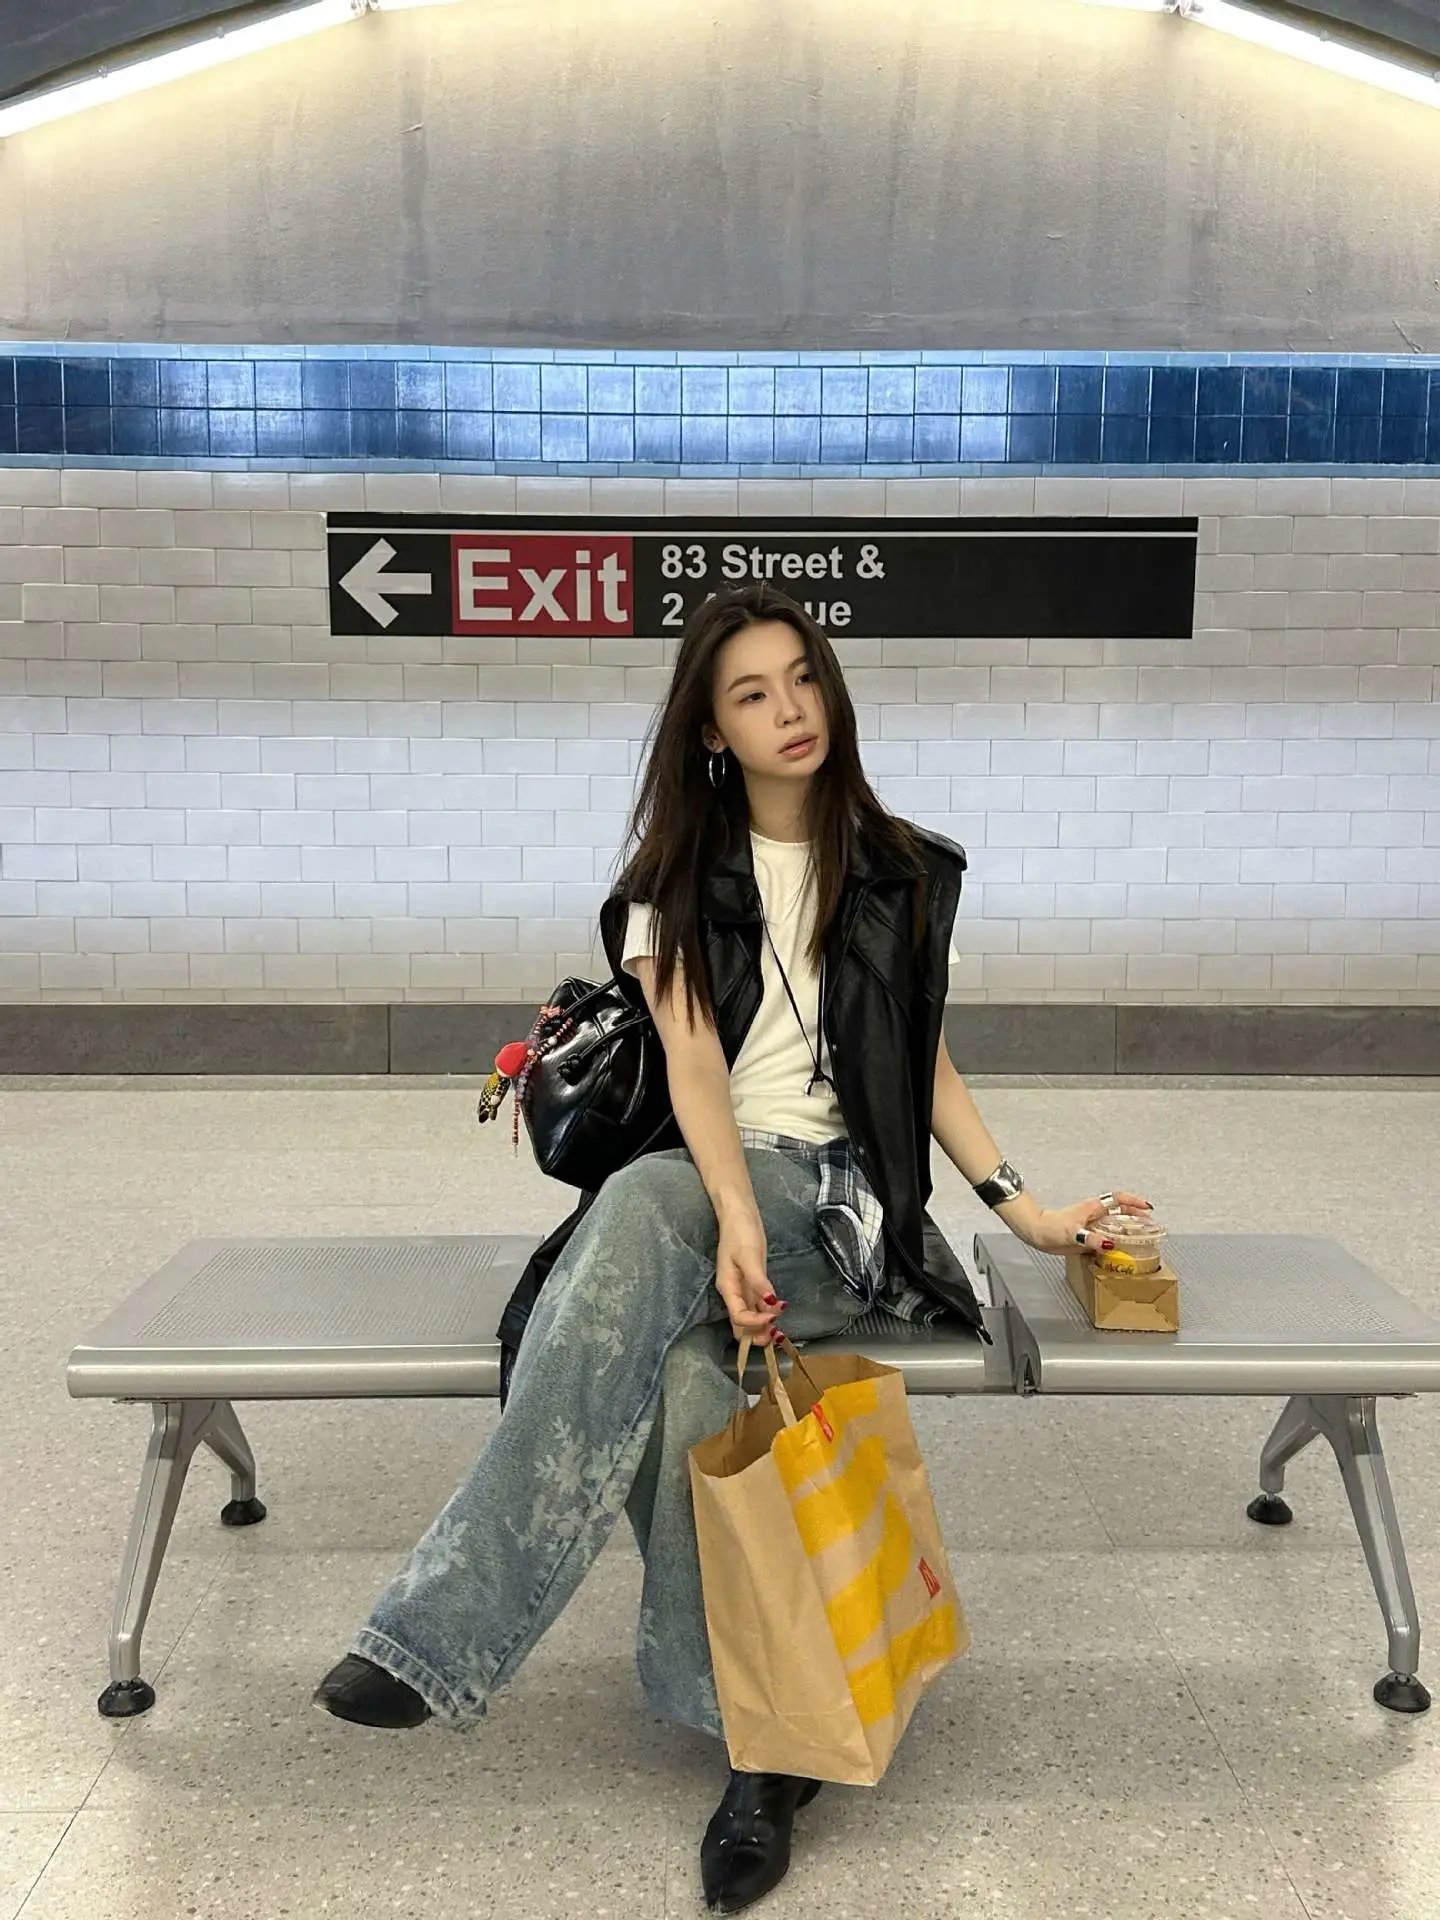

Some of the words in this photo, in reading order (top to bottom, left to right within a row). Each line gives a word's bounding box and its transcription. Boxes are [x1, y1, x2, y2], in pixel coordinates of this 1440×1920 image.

[661, 544, 707, 579] 83
[721, 544, 843, 579] Street
[856, 544, 886, 579] &
[457, 548, 628, 623] Exit
[661, 592, 684, 626] 2
